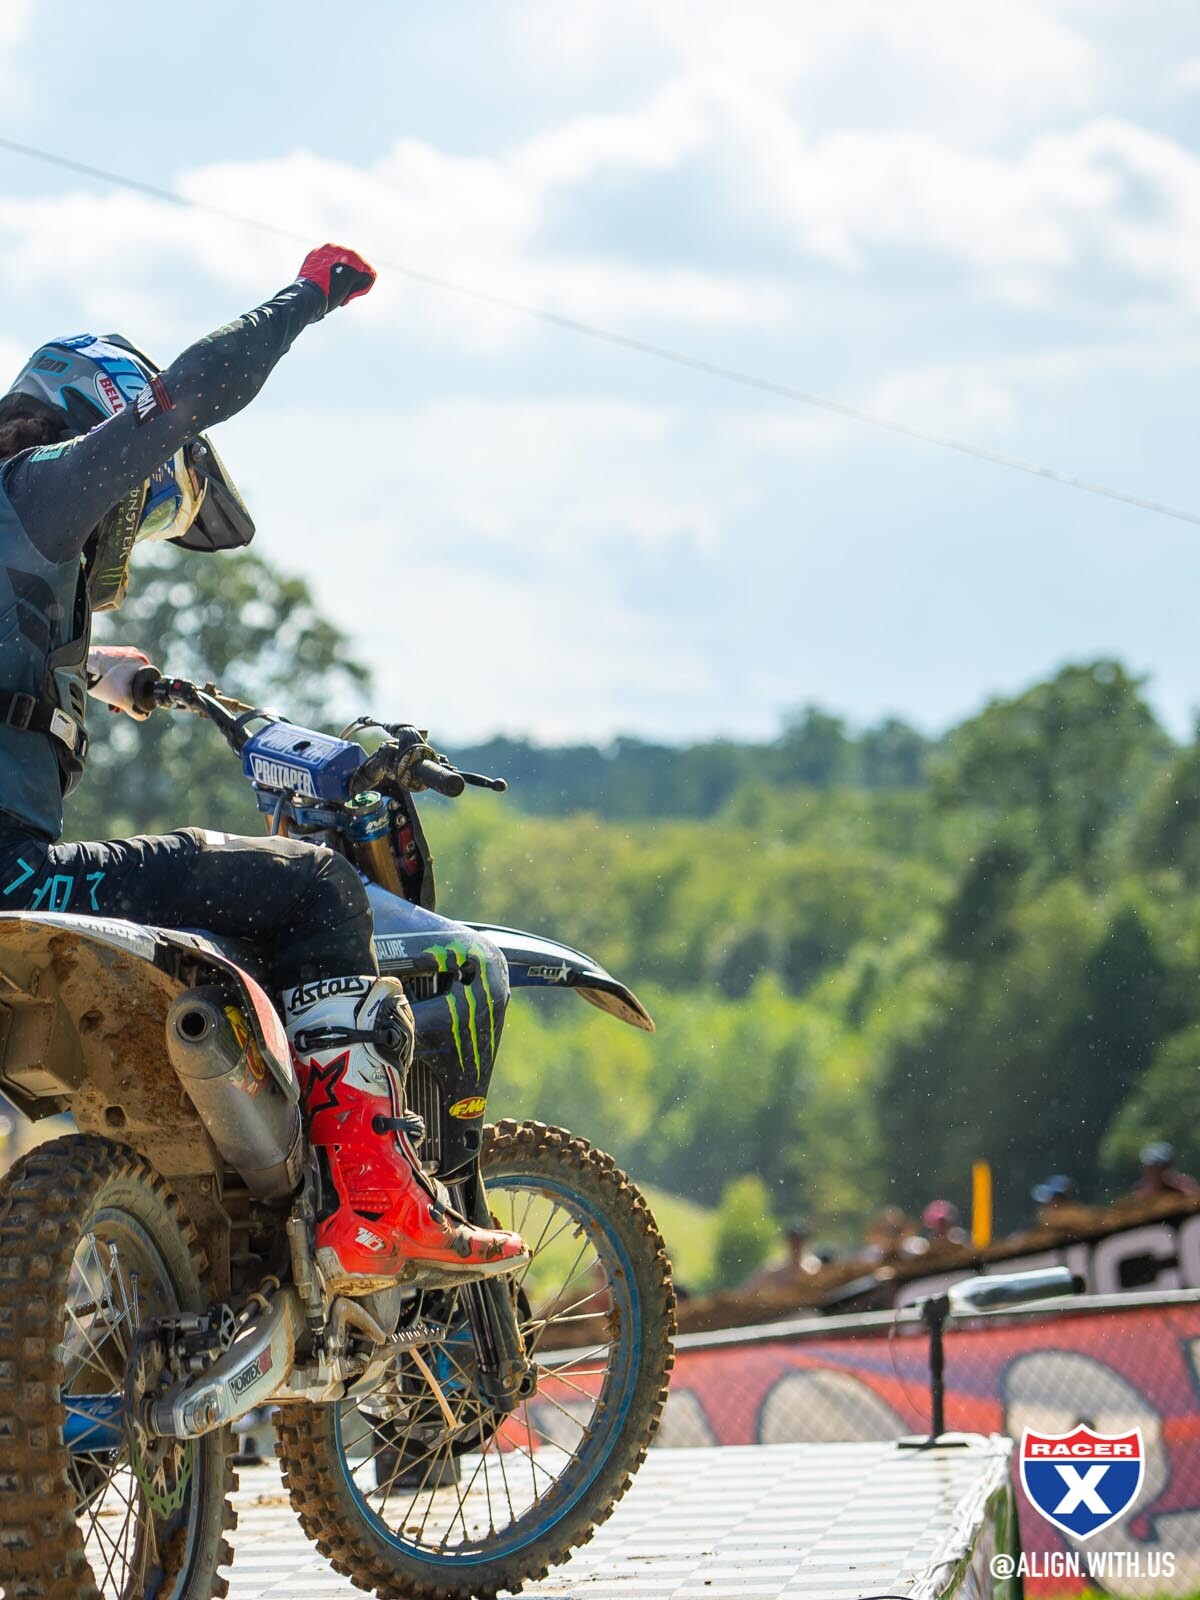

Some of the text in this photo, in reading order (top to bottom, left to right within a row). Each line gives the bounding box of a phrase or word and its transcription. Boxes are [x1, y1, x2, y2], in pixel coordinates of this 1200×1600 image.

[98, 377, 124, 413] BELL
[120, 485, 141, 559] ONSTER
[255, 759, 312, 796] PROTAPER
[374, 940, 408, 959] ALUBE
[231, 1360, 261, 1394] VORTEX
